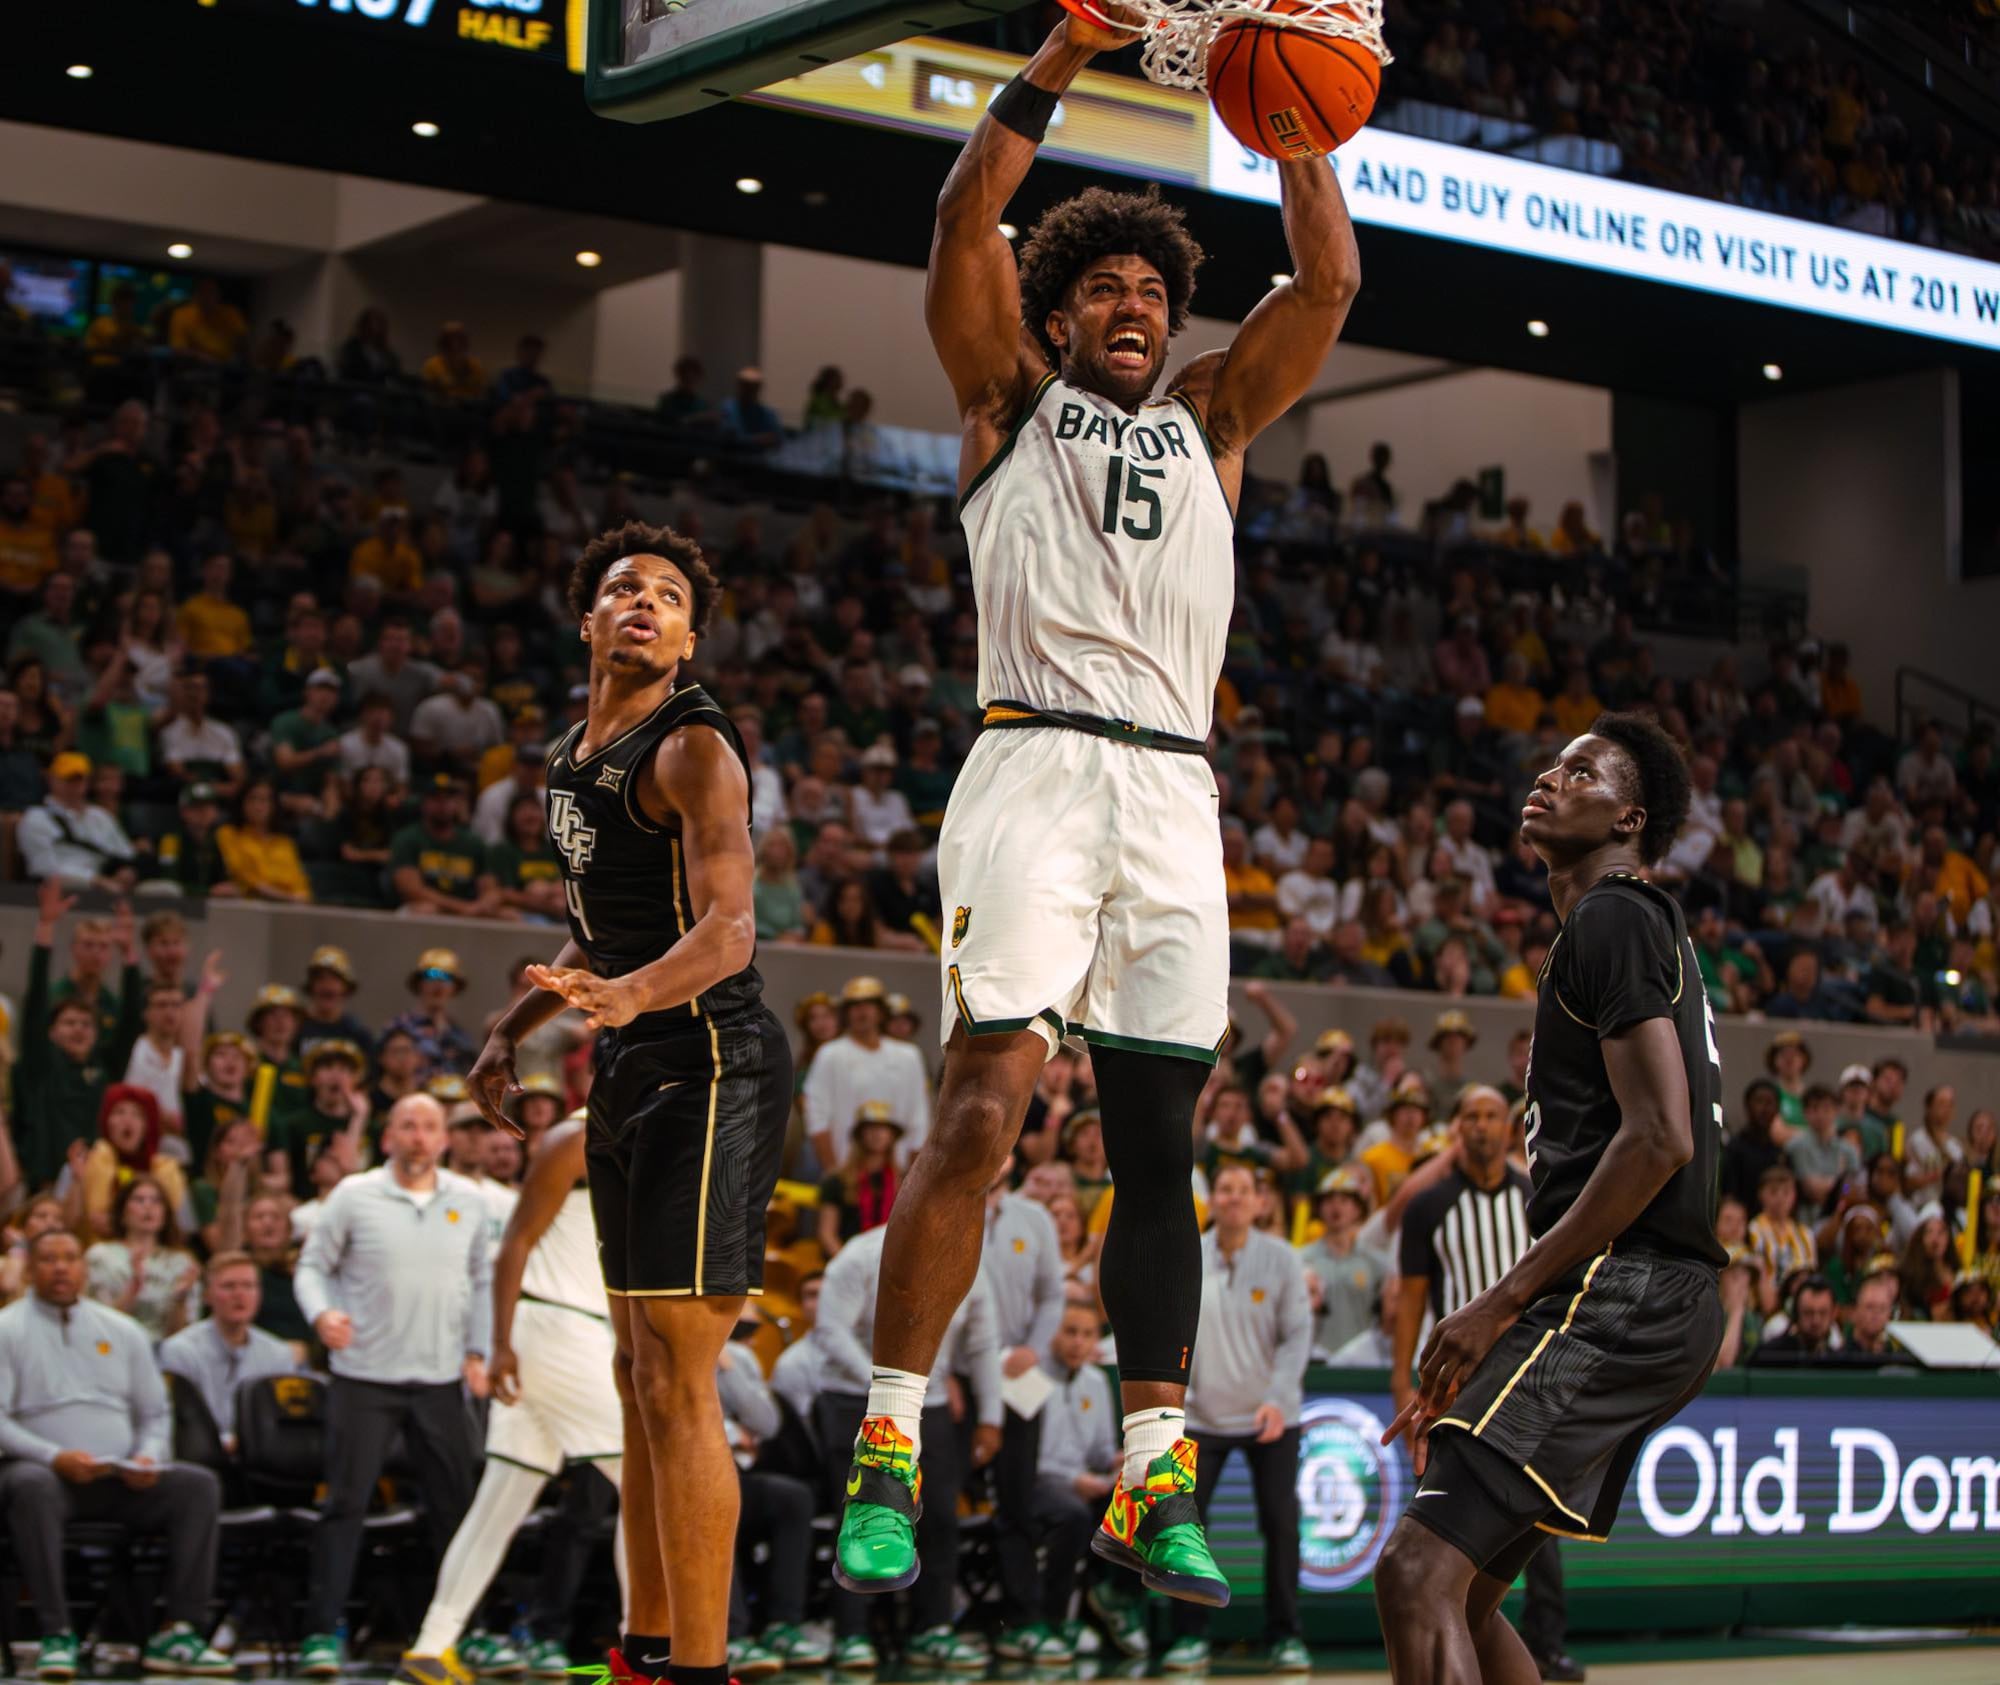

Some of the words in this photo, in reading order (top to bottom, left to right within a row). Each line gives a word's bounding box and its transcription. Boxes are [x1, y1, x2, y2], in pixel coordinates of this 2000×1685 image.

[458, 8, 552, 50] HALF
[1354, 159, 1426, 204] AND
[1442, 175, 1510, 220] BUY
[1525, 194, 1646, 251] ONLINE
[1660, 222, 1702, 261] OR
[1714, 231, 1797, 280] VISIT
[1810, 252, 1850, 292] US
[1862, 265, 1898, 301] AT
[1911, 274, 1959, 315] 201
[1102, 455, 1167, 541] 15
[550, 789, 597, 874] UCF
[565, 878, 594, 942] 4
[1637, 1425, 1805, 1537] Old
